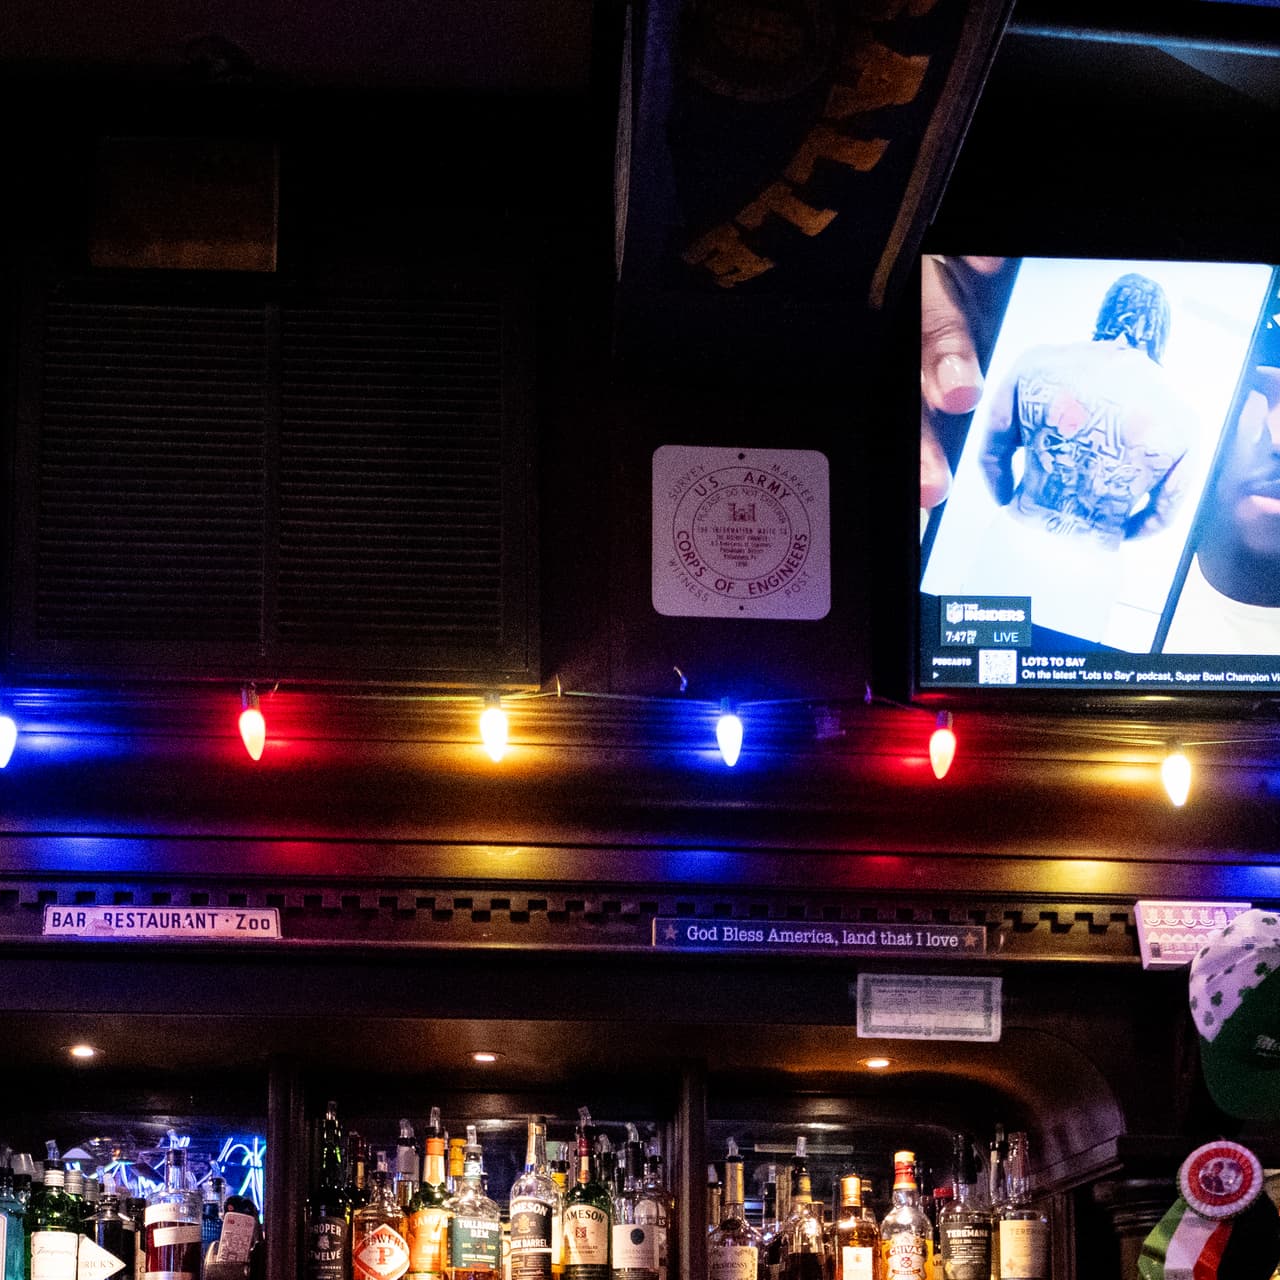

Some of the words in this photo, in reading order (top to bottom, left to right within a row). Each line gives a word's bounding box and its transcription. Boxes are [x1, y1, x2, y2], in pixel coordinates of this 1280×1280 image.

[669, 464, 706, 500] SURVEY
[772, 464, 815, 505] MARKER
[743, 471, 792, 500] ARMY
[677, 530, 707, 578] CORPS
[714, 579, 737, 593] OF
[748, 533, 808, 595] ENGINEERS
[669, 559, 709, 602] WITNESS
[784, 571, 812, 597] POST
[964, 609, 1026, 622] INSIDERS
[945, 631, 967, 643] 7:47
[993, 631, 1019, 643] LIVE
[1022, 657, 1049, 667] LOTS
[1049, 658, 1064, 667] TO
[1065, 658, 1086, 667] SAY
[1022, 670, 1035, 680] On
[1036, 671, 1052, 680] the
[1053, 671, 1077, 680] latest
[1079, 671, 1101, 681] "Lots
[1103, 672, 1113, 681] to
[1114, 671, 1135, 683] Say"
[1136, 672, 1174, 684] podcast,
[1175, 672, 1201, 684] Super
[1203, 672, 1225, 682] Bowl
[1226, 672, 1269, 684] Champion
[52, 912, 86, 928] BAR
[104, 913, 218, 929] RESTAURANT
[236, 914, 270, 930] Zoo
[687, 926, 718, 941] God
[722, 927, 764, 942] Bless
[767, 929, 839, 946] America,
[842, 931, 877, 946] land
[879, 932, 913, 947] that
[916, 933, 925, 947] I
[926, 933, 959, 948] love
[523, 1239, 549, 1249] BARREL
[888, 1245, 924, 1257] CHIVAS
[309, 1249, 342, 1263] TWELVE
[377, 1247, 395, 1265] P
